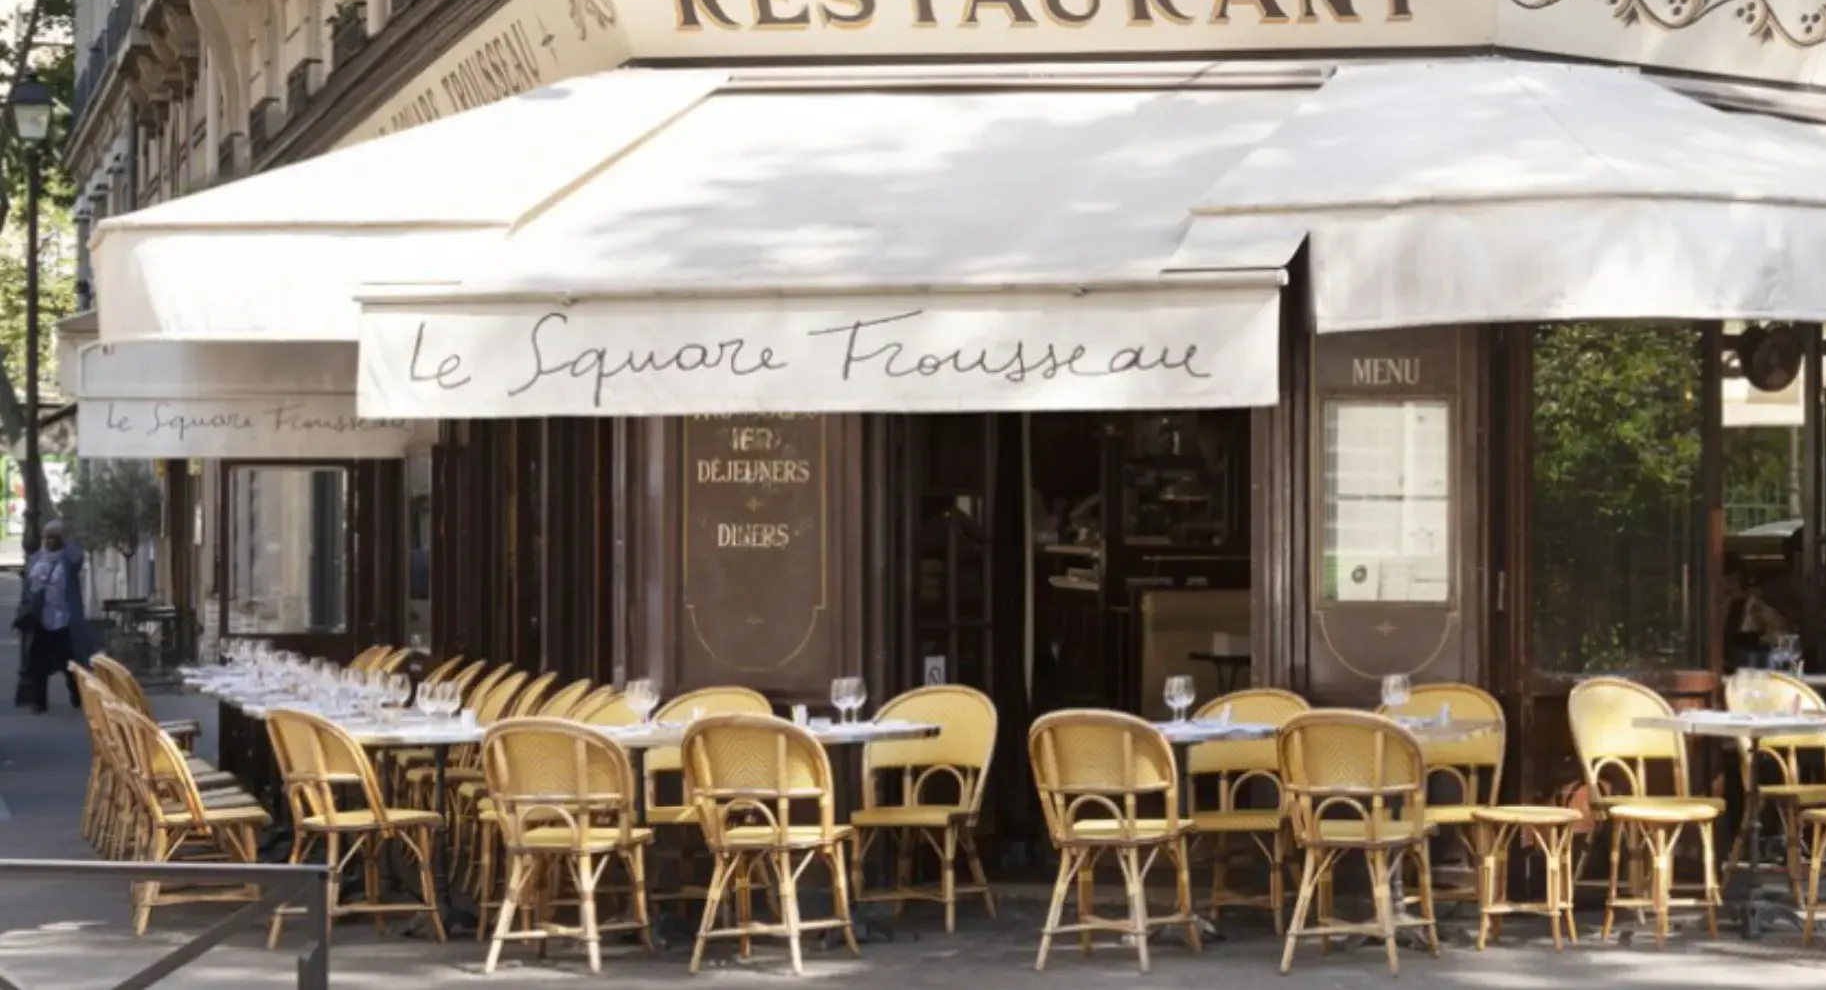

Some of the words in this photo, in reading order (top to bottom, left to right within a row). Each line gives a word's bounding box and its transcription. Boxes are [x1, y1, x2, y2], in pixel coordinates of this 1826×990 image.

[409, 320, 471, 388] Le
[508, 312, 788, 406] Square
[808, 309, 1212, 381] Trousseau
[1352, 358, 1420, 385] MENU
[146, 402, 255, 441] Square
[263, 398, 410, 433] Trousseau
